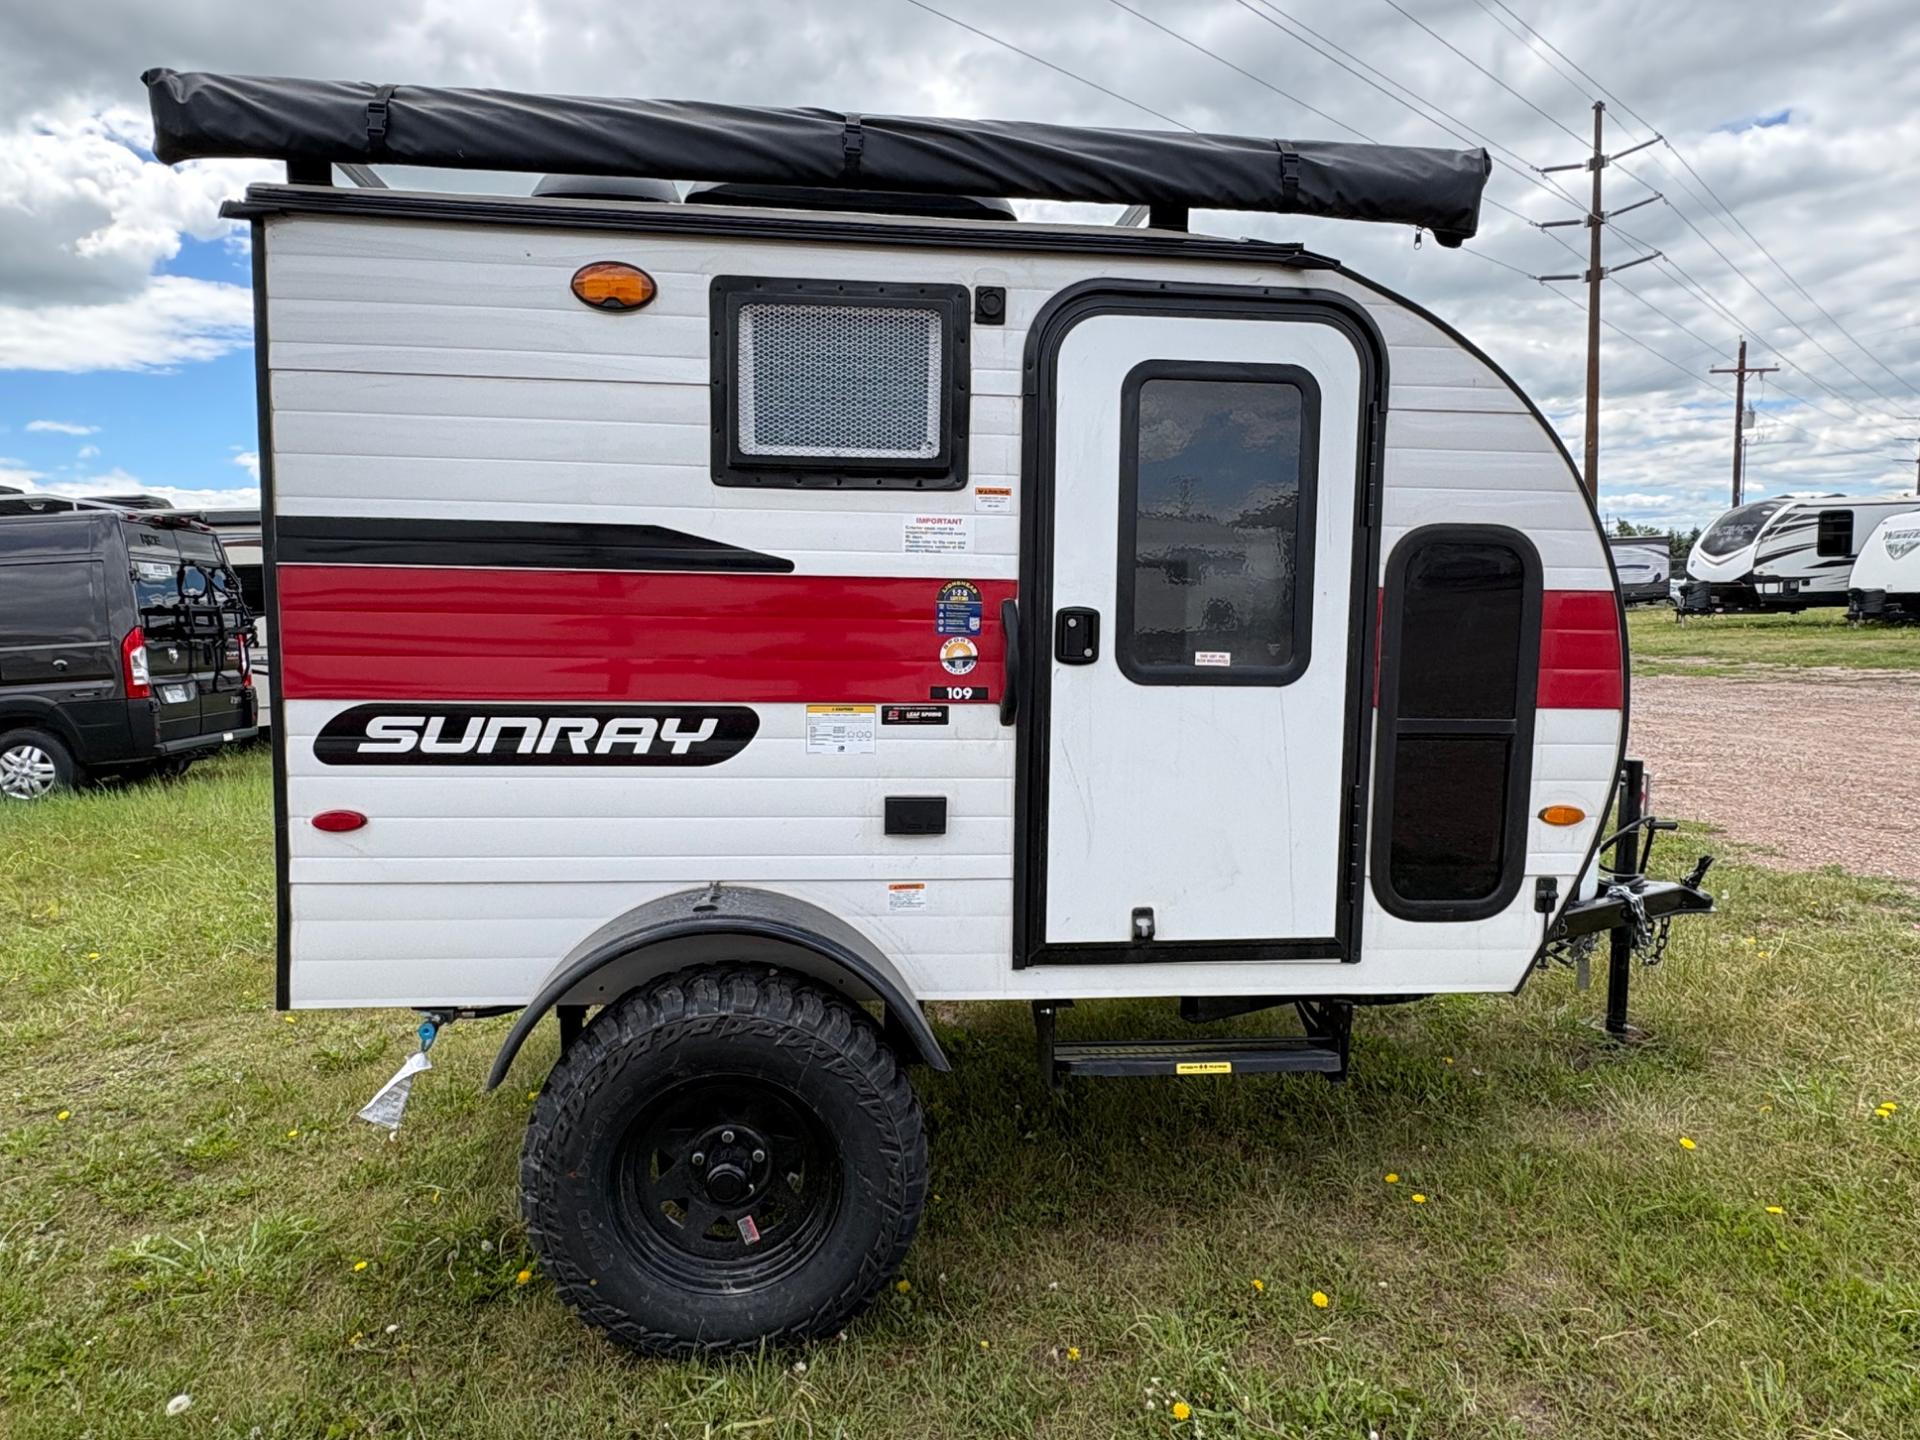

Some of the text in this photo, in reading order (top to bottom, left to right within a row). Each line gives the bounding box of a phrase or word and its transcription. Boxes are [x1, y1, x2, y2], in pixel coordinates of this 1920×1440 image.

[916, 517, 963, 525] IMPORTANT
[942, 580, 977, 593] LIONSHEAD
[943, 638, 971, 650] SPORT
[946, 687, 973, 700] 109
[357, 716, 719, 755] SUNRAY
